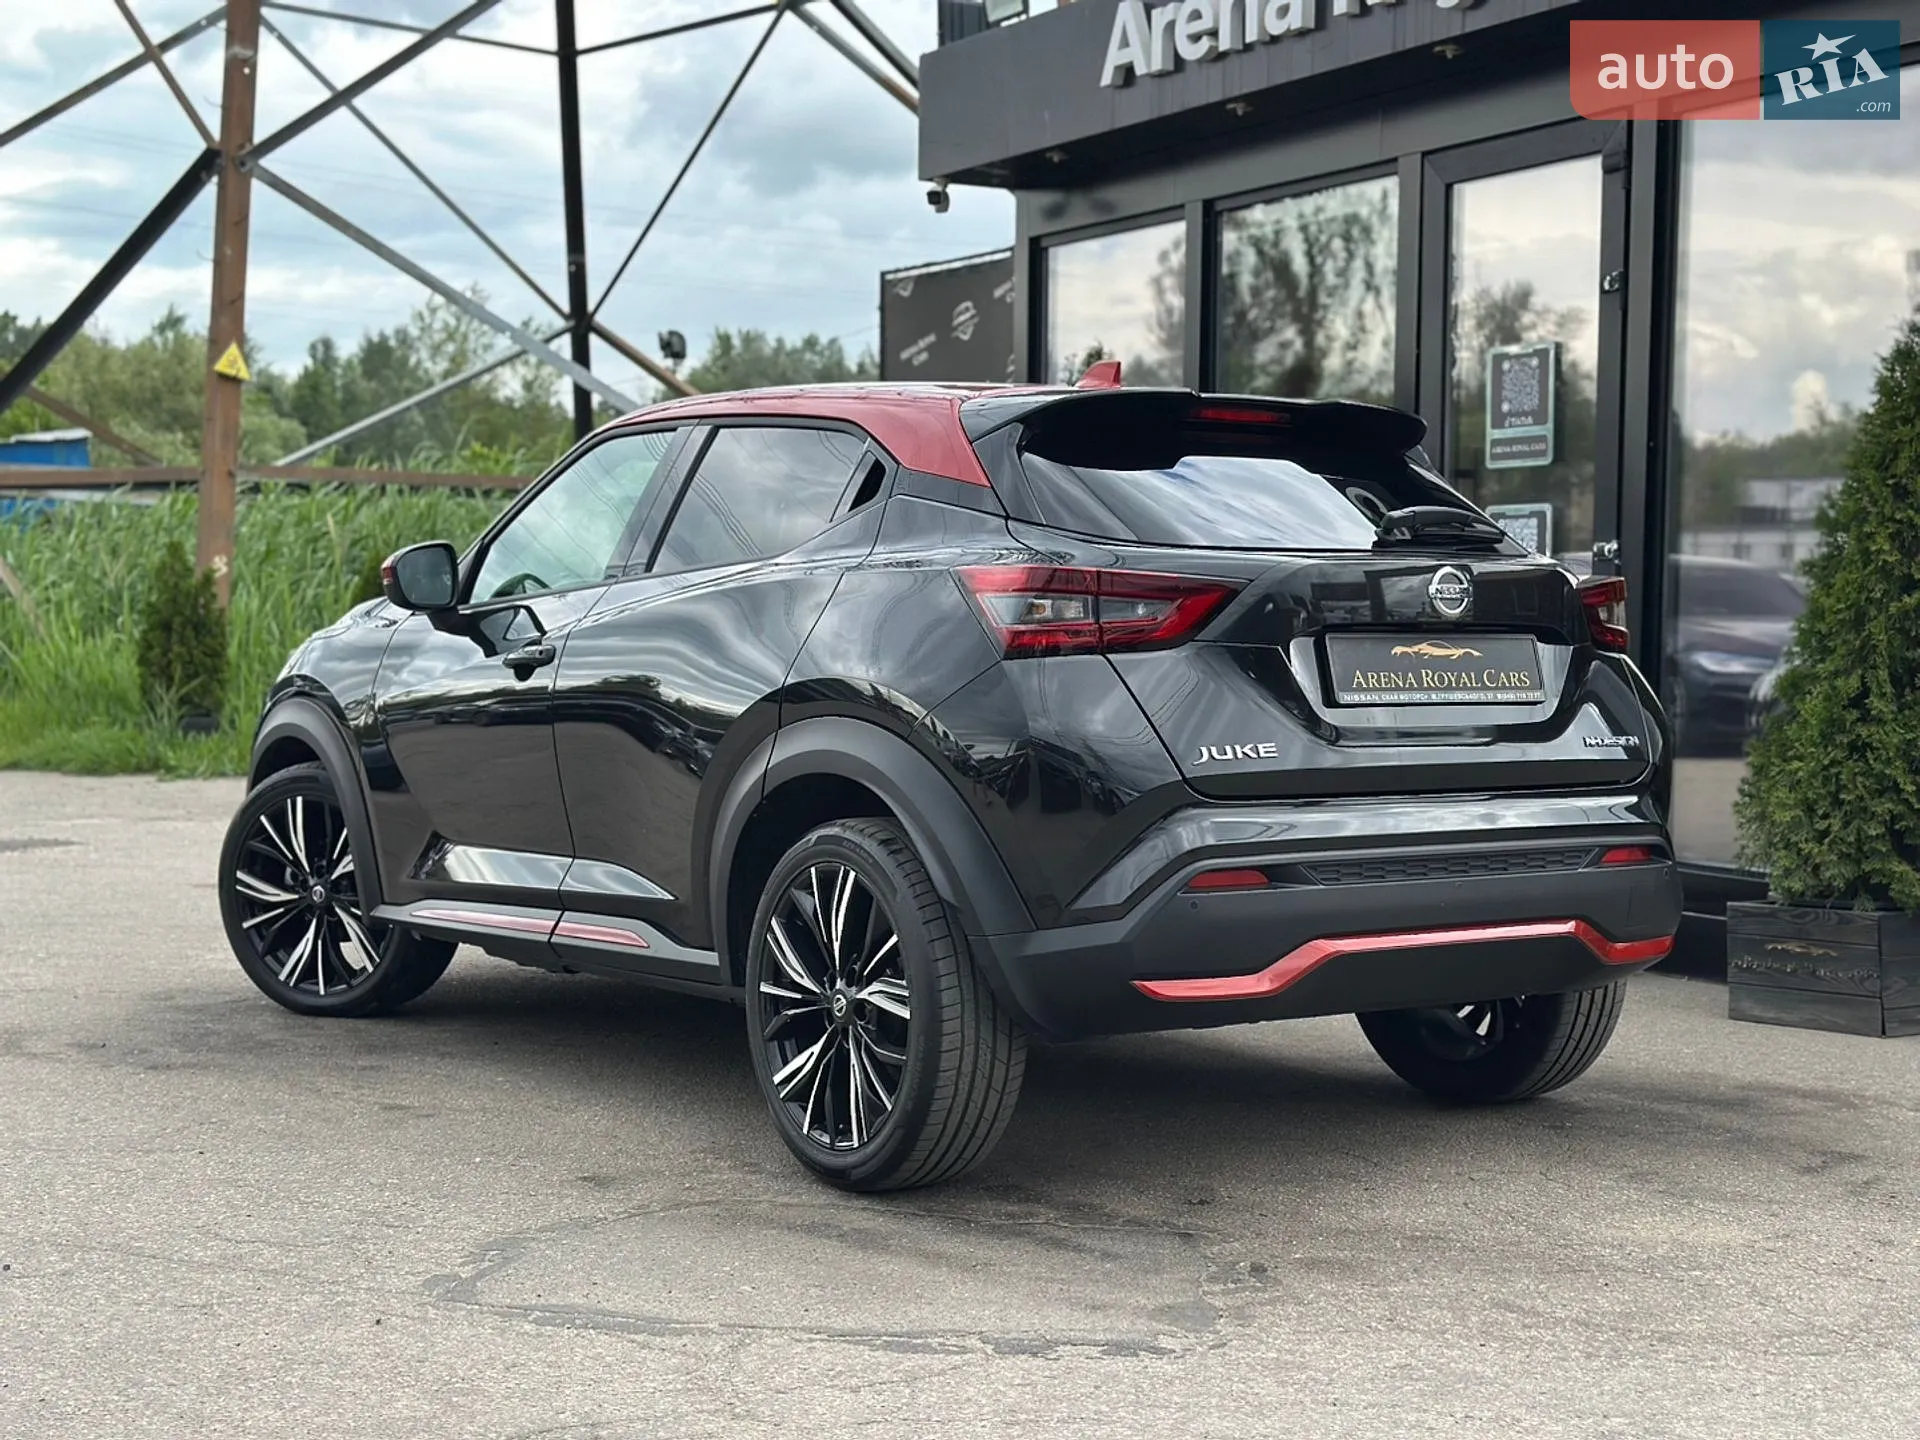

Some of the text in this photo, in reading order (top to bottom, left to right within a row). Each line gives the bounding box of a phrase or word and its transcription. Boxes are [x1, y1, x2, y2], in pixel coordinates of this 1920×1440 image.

[1352, 668, 1530, 689] ARENA ROYAL CARS
[1343, 693, 1379, 702] NISSAN
[1192, 742, 1279, 766] JUKE
